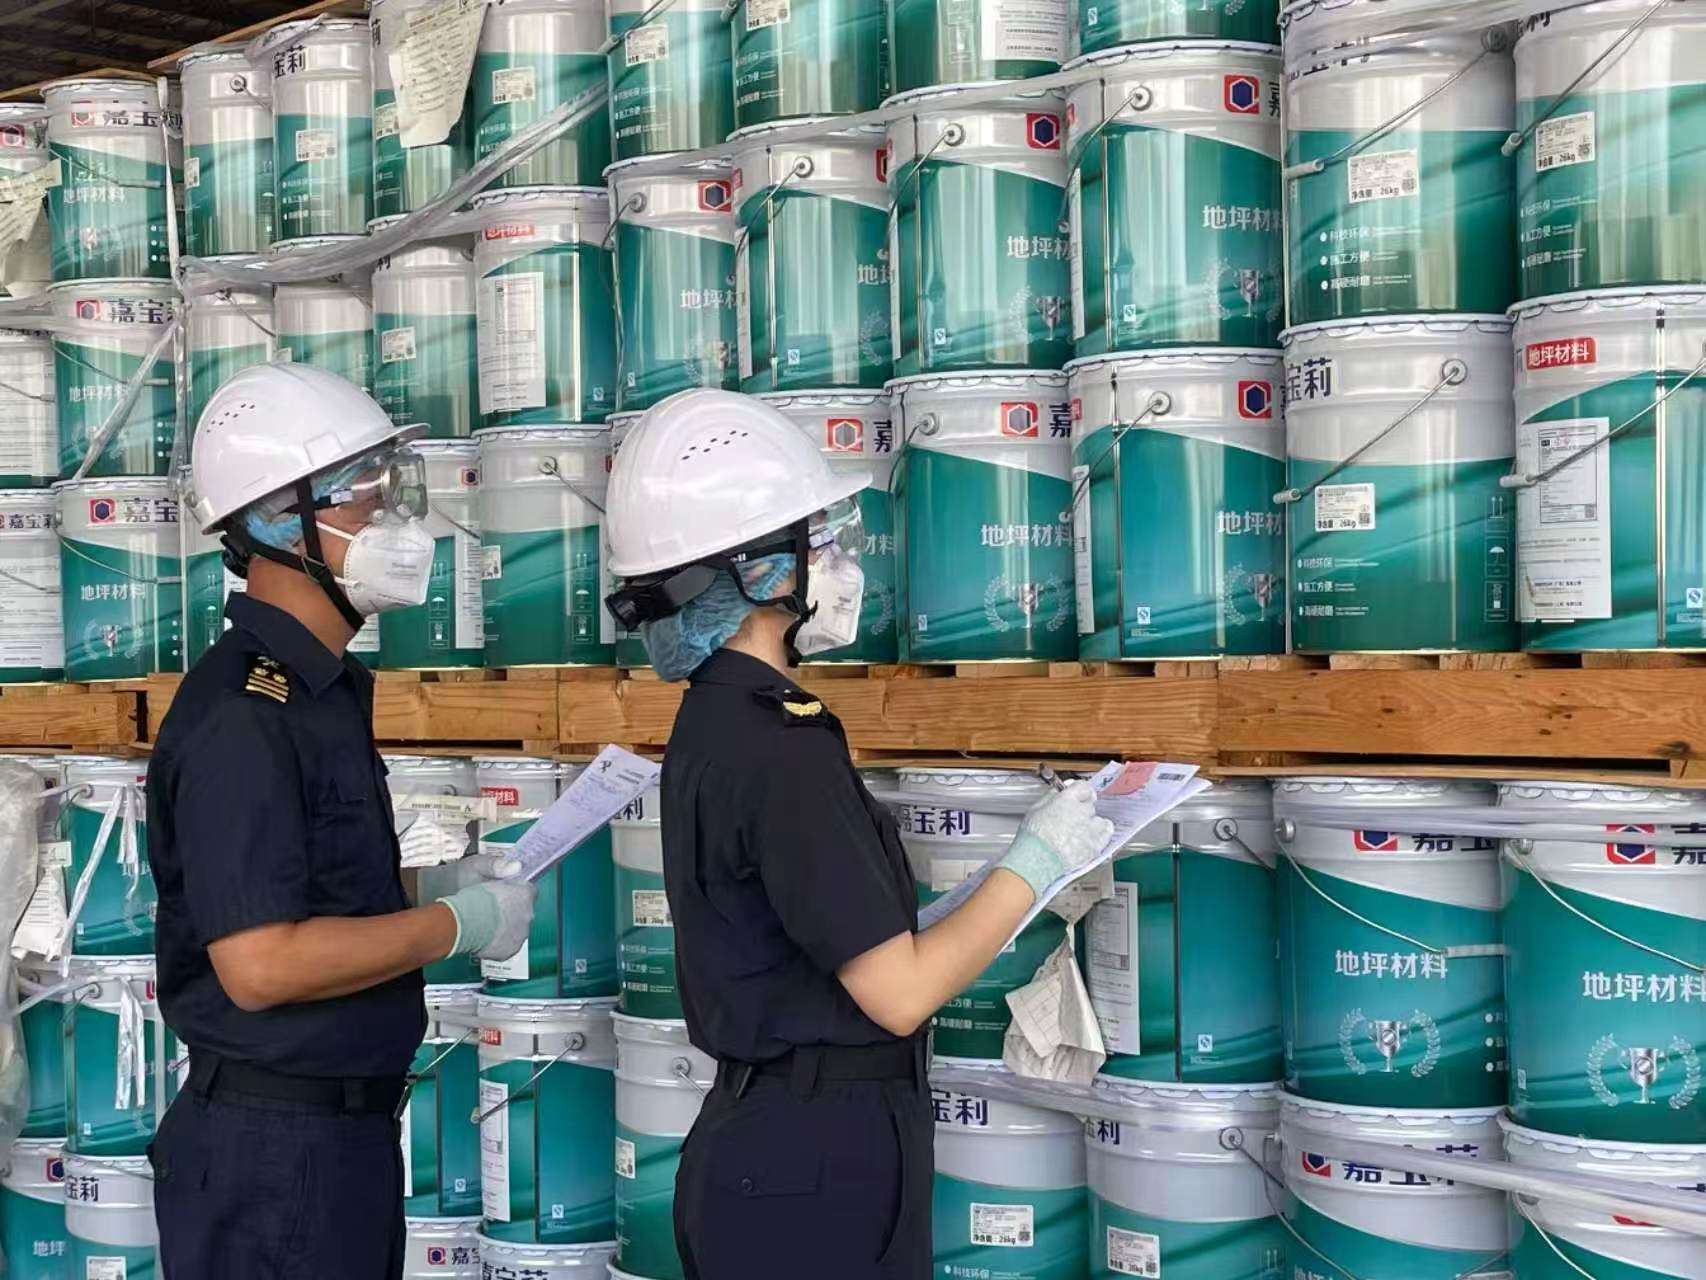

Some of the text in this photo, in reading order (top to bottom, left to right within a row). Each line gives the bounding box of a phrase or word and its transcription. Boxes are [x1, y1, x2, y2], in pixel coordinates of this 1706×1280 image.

[1528, 342, 1590, 368] 地坪材料
[80, 583, 147, 601] 地坪材料
[1335, 950, 1448, 978] 地坪材料
[1583, 971, 1706, 1003] 地坪材料
